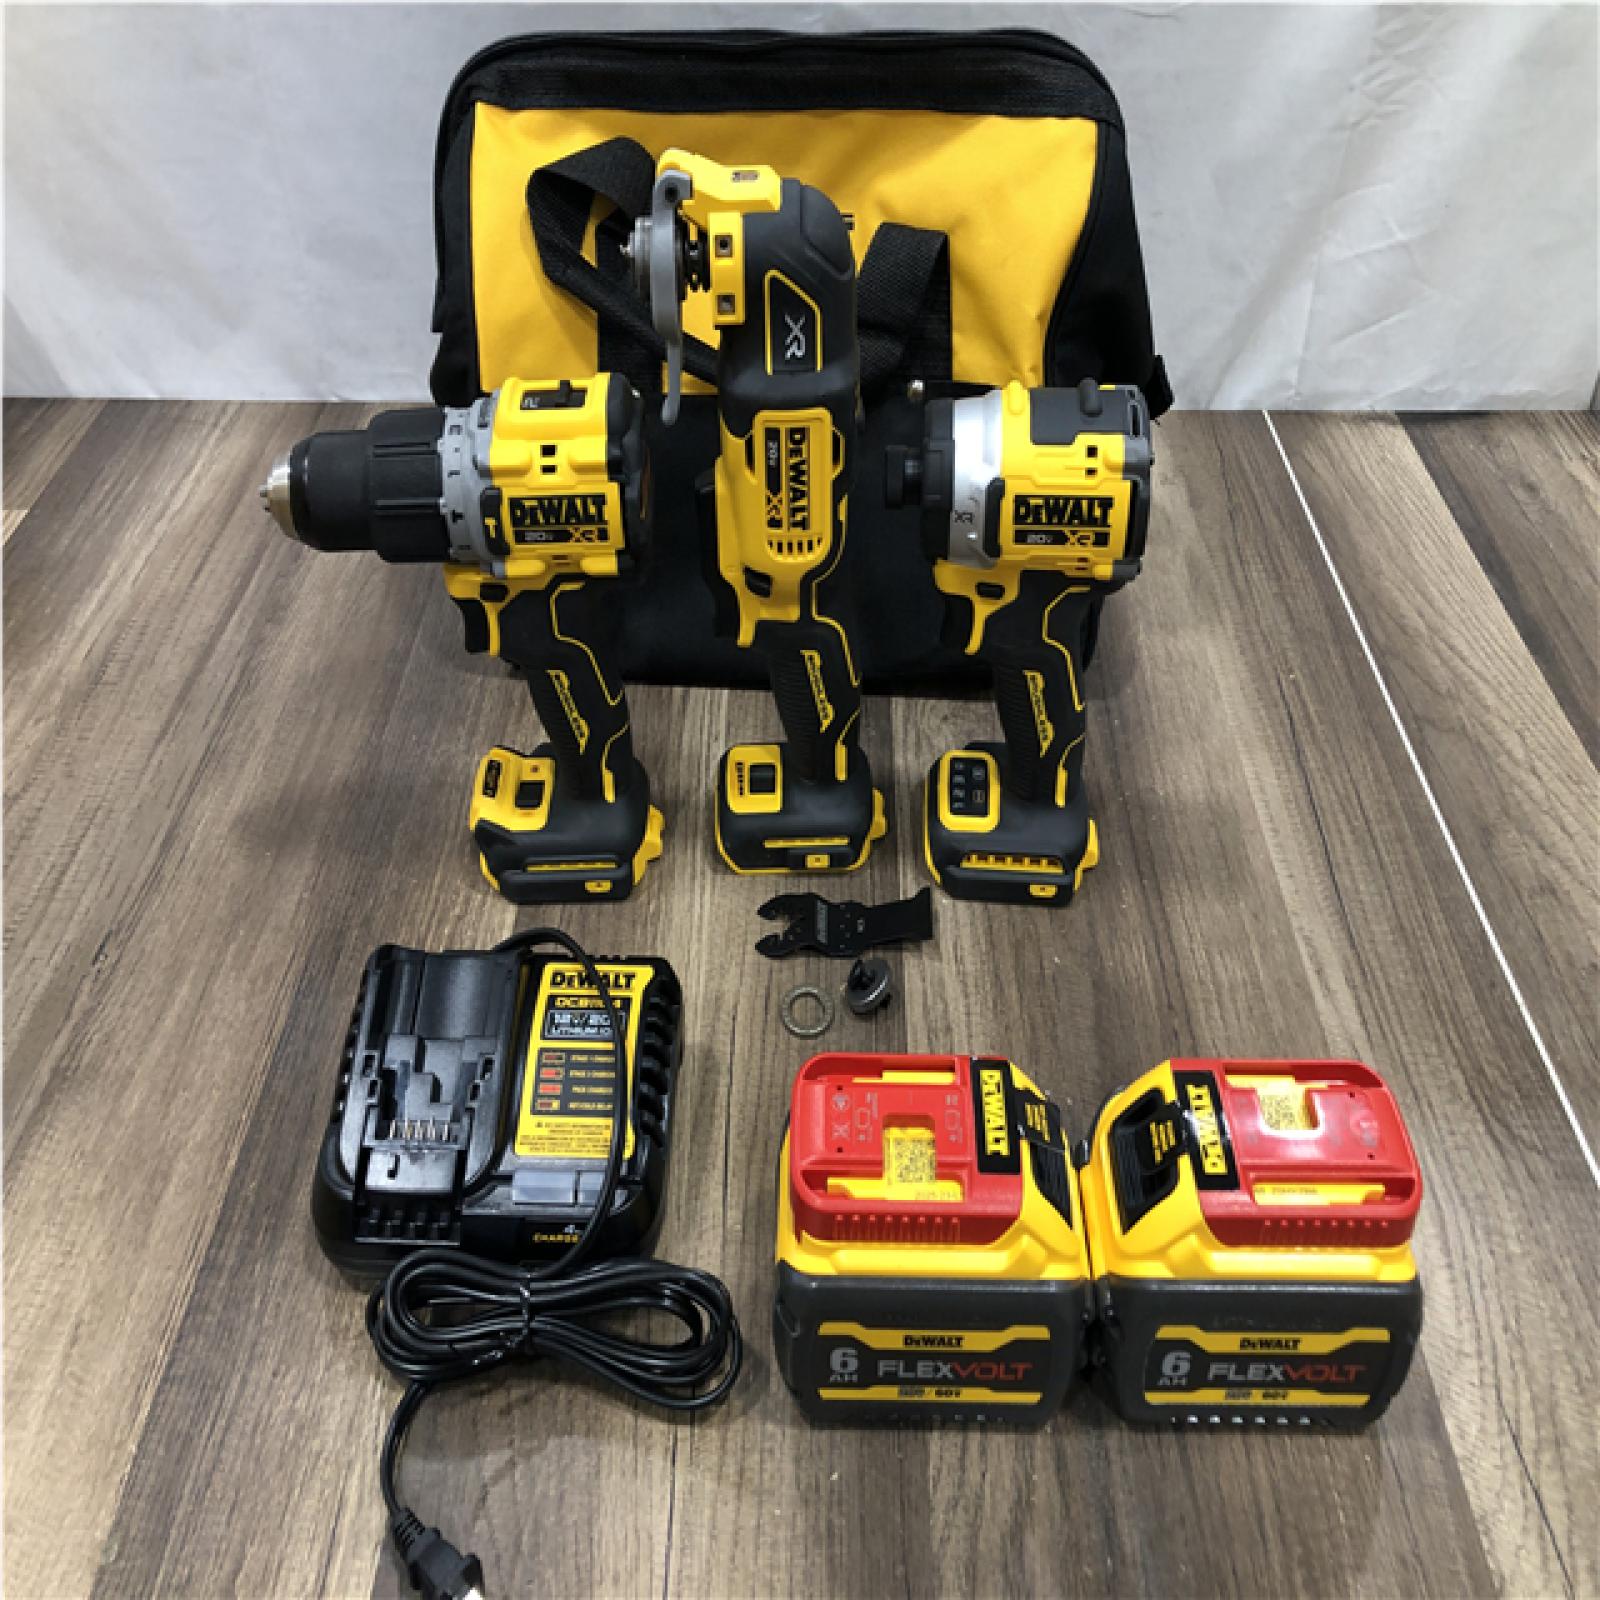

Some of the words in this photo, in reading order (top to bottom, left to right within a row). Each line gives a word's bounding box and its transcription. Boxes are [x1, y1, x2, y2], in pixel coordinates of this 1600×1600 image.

[785, 314, 805, 360] XR
[830, 1347, 858, 1374] 6
[877, 1359, 1033, 1381] FLEXVOLT
[1162, 1351, 1191, 1376] 6
[1207, 1362, 1367, 1382] FLEXVOLT
